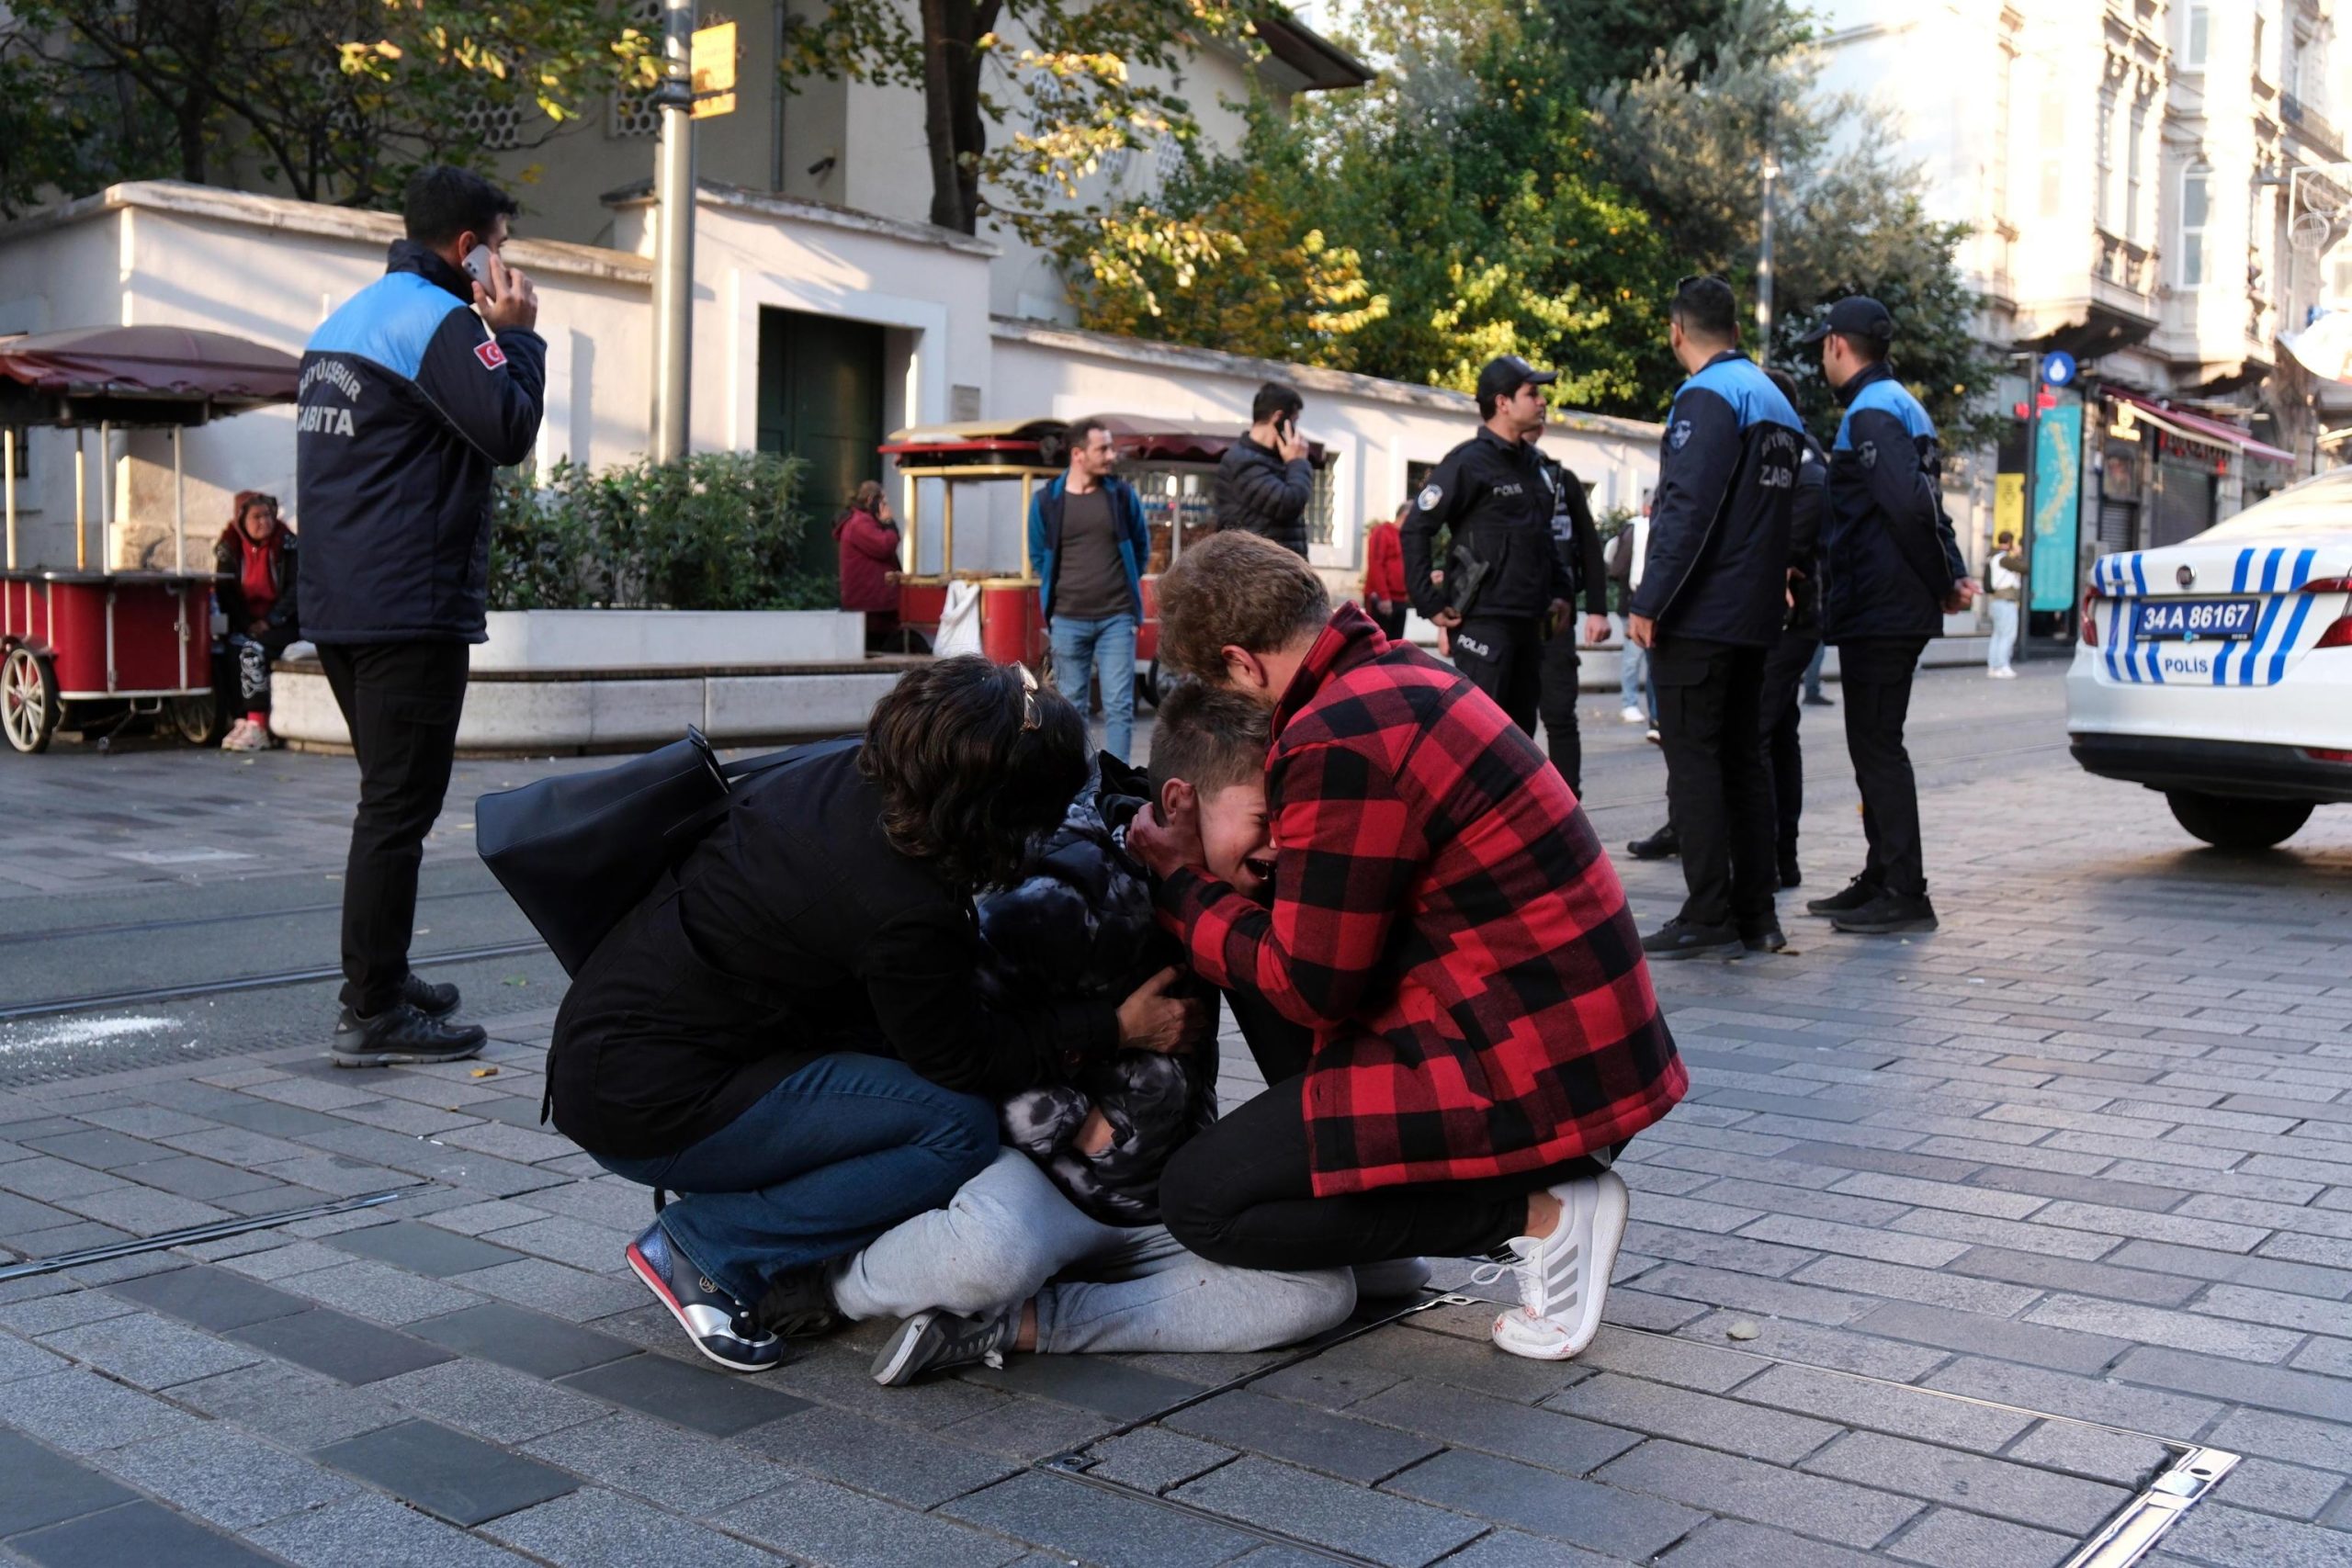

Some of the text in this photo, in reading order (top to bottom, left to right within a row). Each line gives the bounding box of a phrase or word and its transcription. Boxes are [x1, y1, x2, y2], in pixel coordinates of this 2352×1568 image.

[2143, 604, 2250, 630] 34 A 86167
